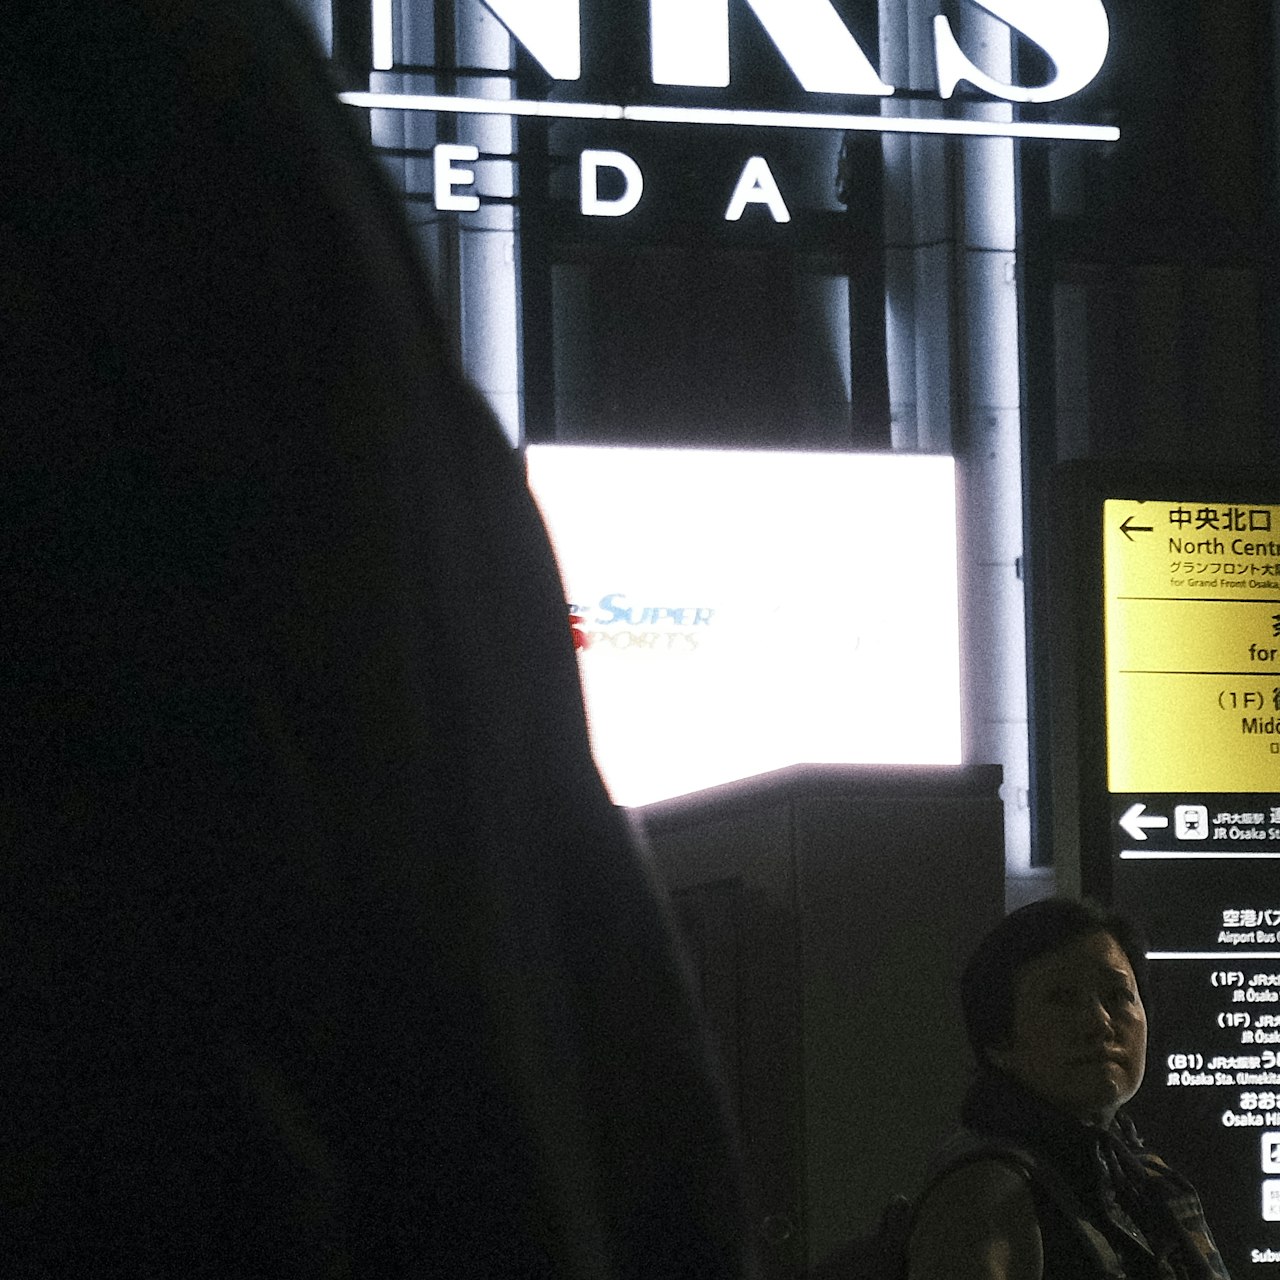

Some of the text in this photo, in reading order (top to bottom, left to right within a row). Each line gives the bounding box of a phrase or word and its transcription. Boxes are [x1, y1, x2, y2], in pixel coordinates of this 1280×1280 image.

[434, 143, 790, 223] EDA
[1169, 506, 1272, 532] 中央北口
[1169, 538, 1225, 555] North
[1170, 578, 1183, 587] for
[1188, 579, 1217, 588] Grand
[1221, 579, 1246, 588] Front
[595, 593, 715, 625] SUPER
[1249, 644, 1276, 662] for
[1218, 691, 1264, 712] (1F)
[1212, 828, 1228, 840] JR
[1218, 931, 1255, 945] Airport
[1256, 931, 1276, 943] Bus
[1210, 971, 1244, 987] (1F)
[1232, 990, 1245, 1002] JR
[1217, 1012, 1250, 1028] (1F)
[1241, 1030, 1254, 1043] JR
[1168, 1053, 1203, 1070] (B1)
[1167, 1072, 1180, 1086] JR
[1215, 1072, 1236, 1085] Sta.
